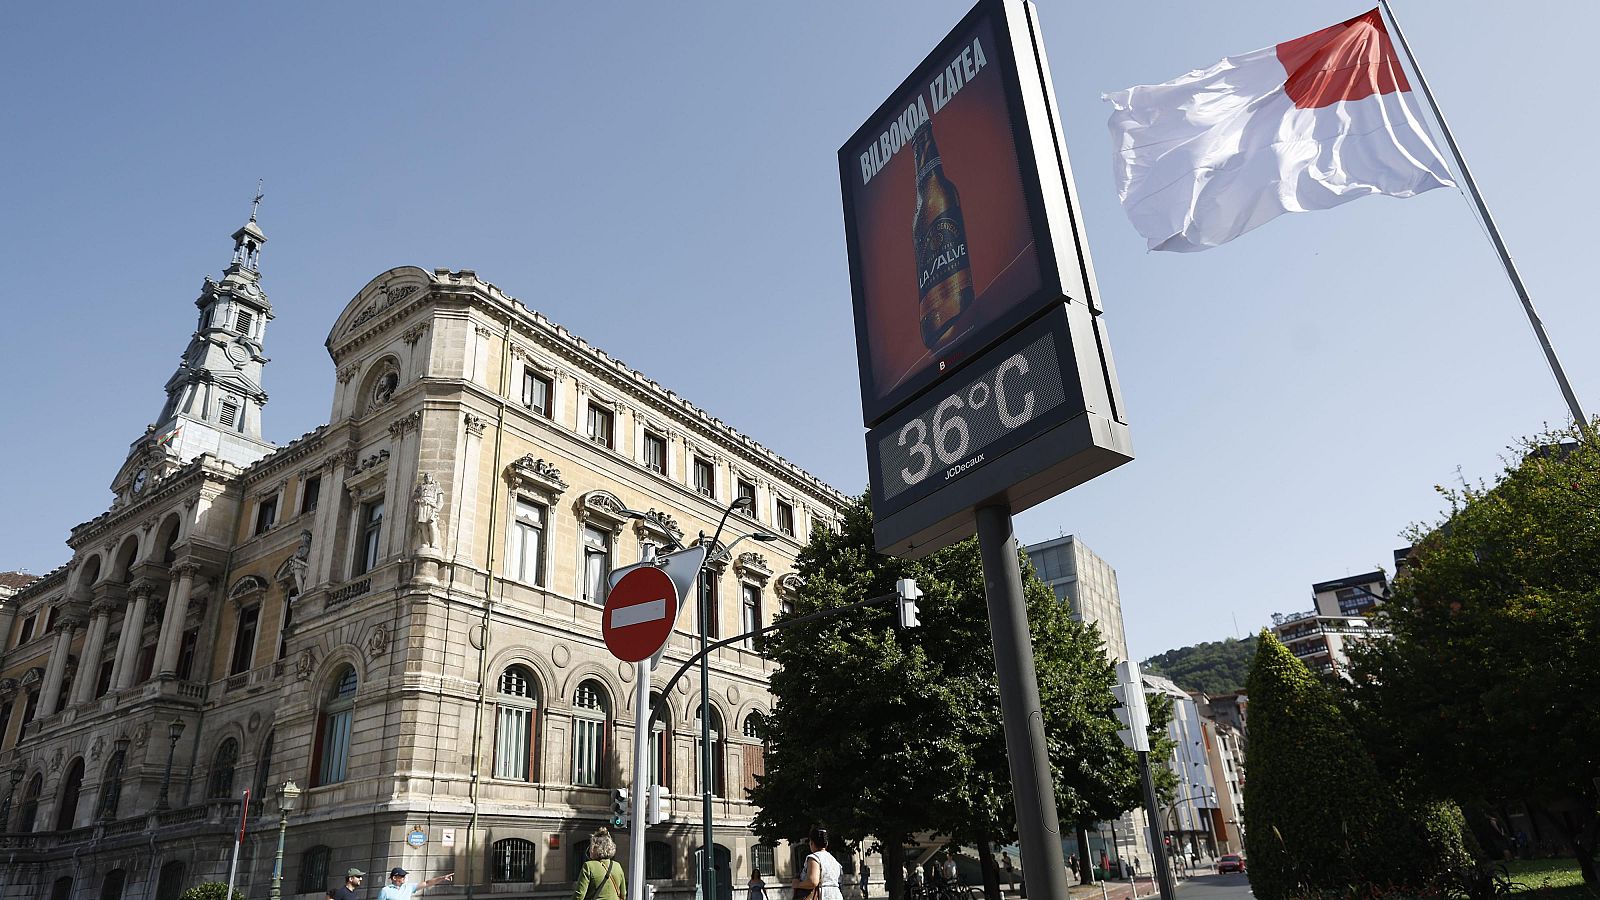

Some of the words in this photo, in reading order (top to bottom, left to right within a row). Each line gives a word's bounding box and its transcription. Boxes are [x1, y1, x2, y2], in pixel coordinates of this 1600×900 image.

[859, 94, 930, 185] BILBOKOA
[930, 37, 987, 114] IZATEA
[919, 270, 930, 289] LA
[930, 243, 966, 275] SALVE
[944, 453, 985, 480] JCDecaux
